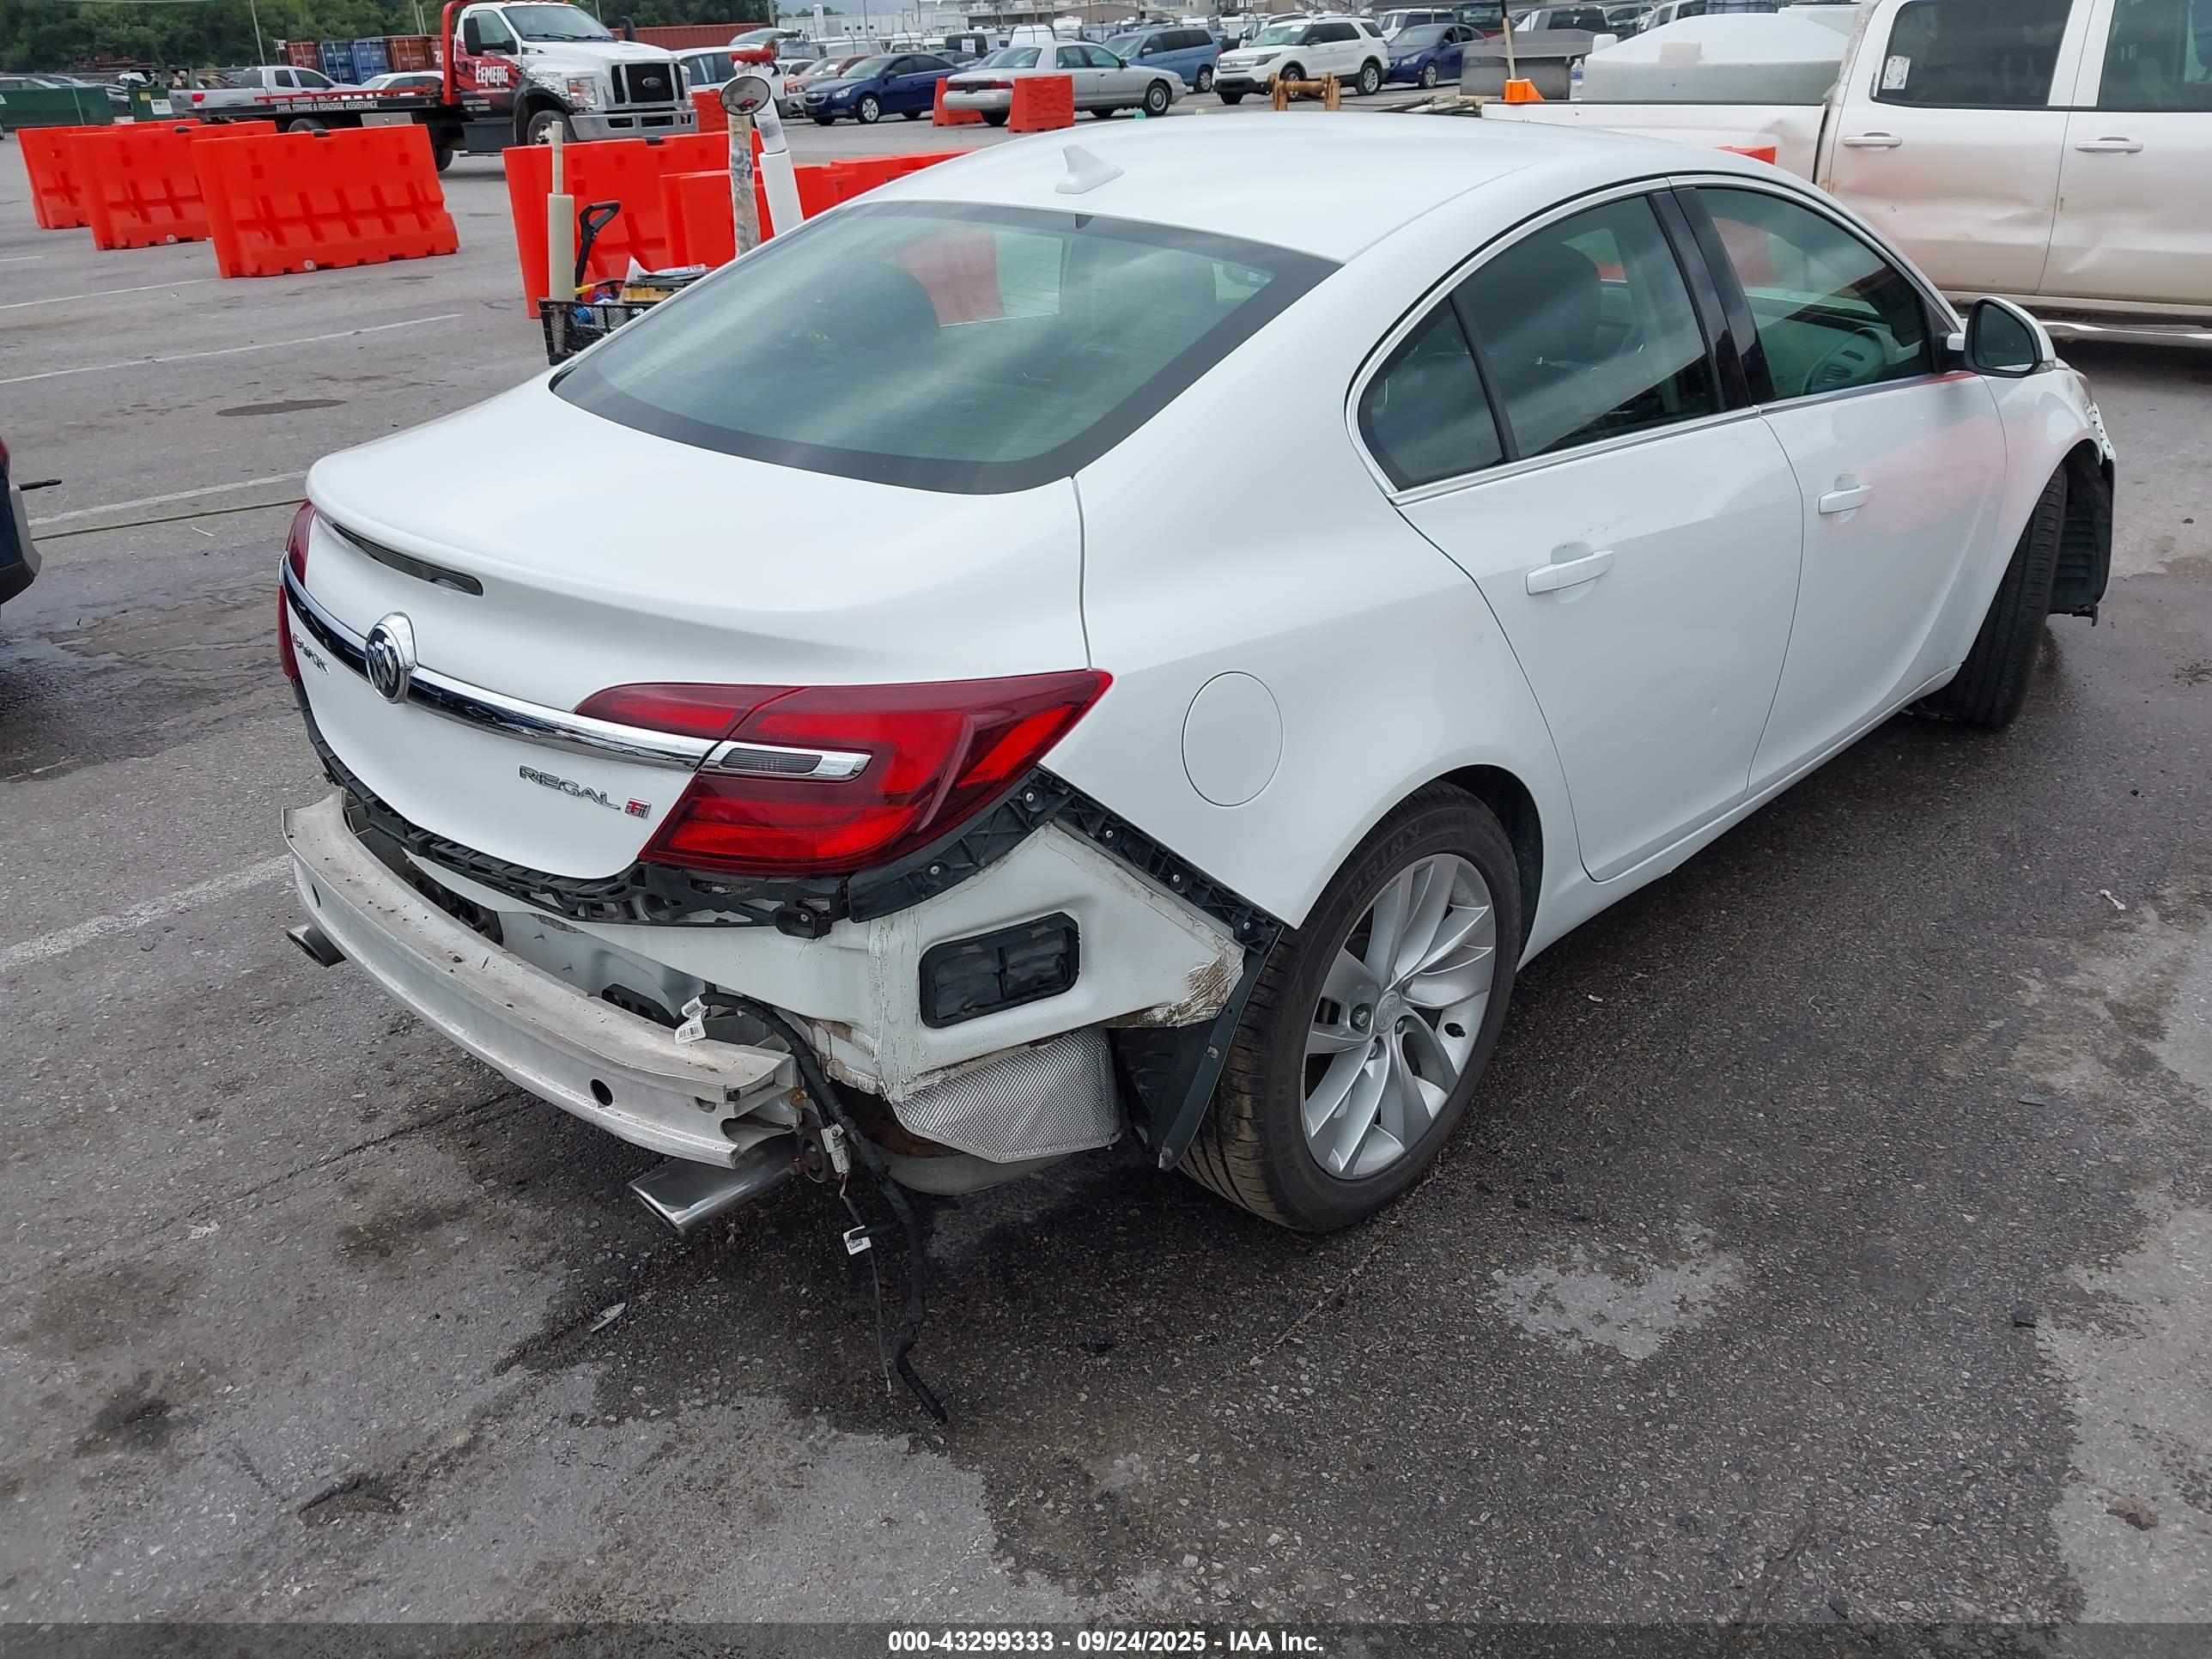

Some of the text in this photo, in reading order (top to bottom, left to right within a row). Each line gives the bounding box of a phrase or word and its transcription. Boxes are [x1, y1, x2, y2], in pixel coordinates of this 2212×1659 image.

[293, 103, 313, 112] TOWING
[318, 101, 345, 110] ROADSIDE
[346, 100, 379, 110] ASSISTANCE
[519, 764, 621, 811] REGAL
